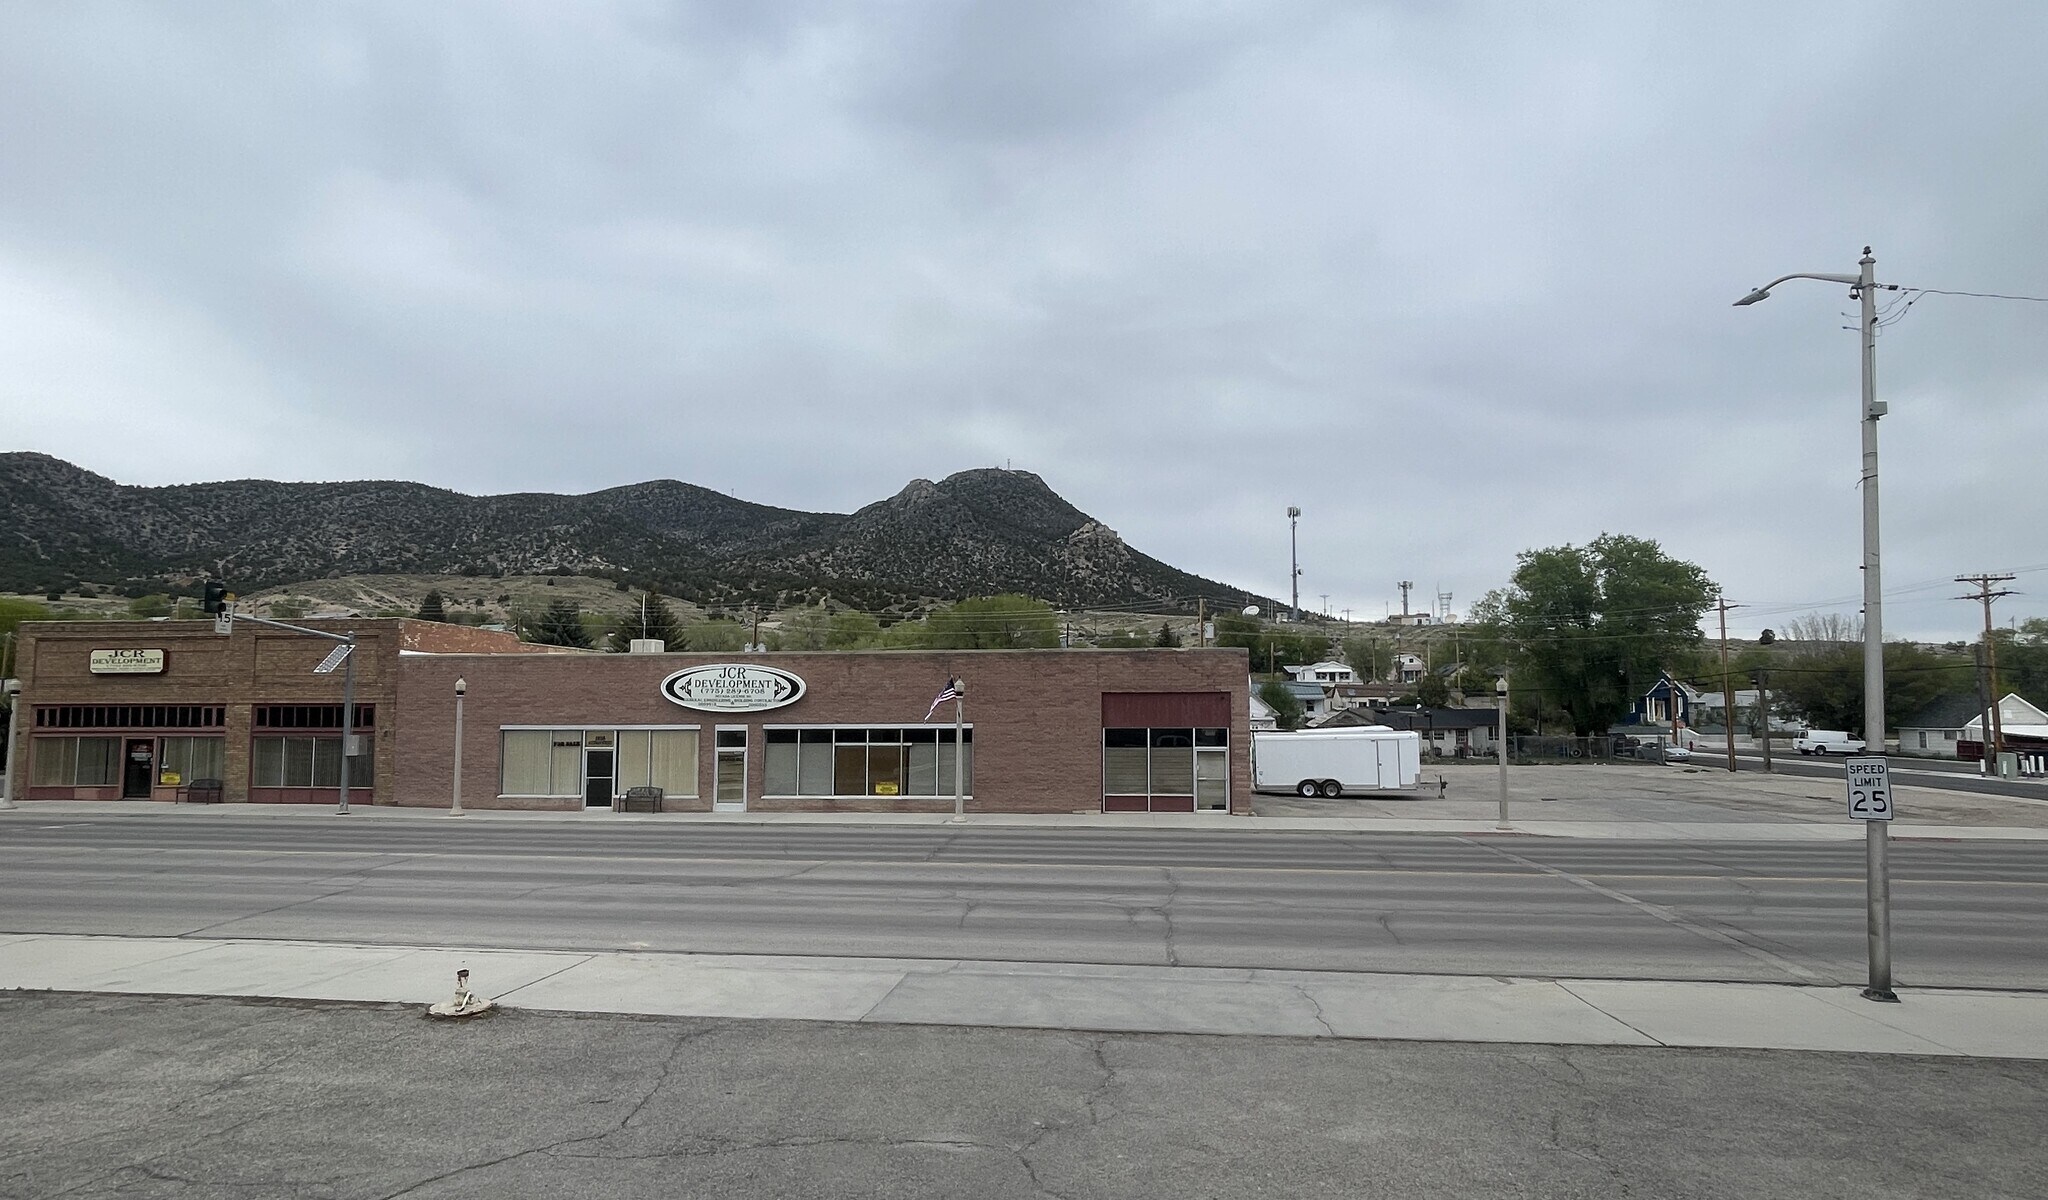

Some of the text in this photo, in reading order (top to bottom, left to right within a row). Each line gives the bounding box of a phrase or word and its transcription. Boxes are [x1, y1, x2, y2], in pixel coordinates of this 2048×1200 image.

[108, 650, 146, 658] JCR
[719, 667, 746, 679] JCR
[694, 679, 772, 688] DEVELOPMENT
[1849, 764, 1885, 775] SPEED
[1854, 777, 1882, 787] LIMIT
[1852, 790, 1887, 813] 25
